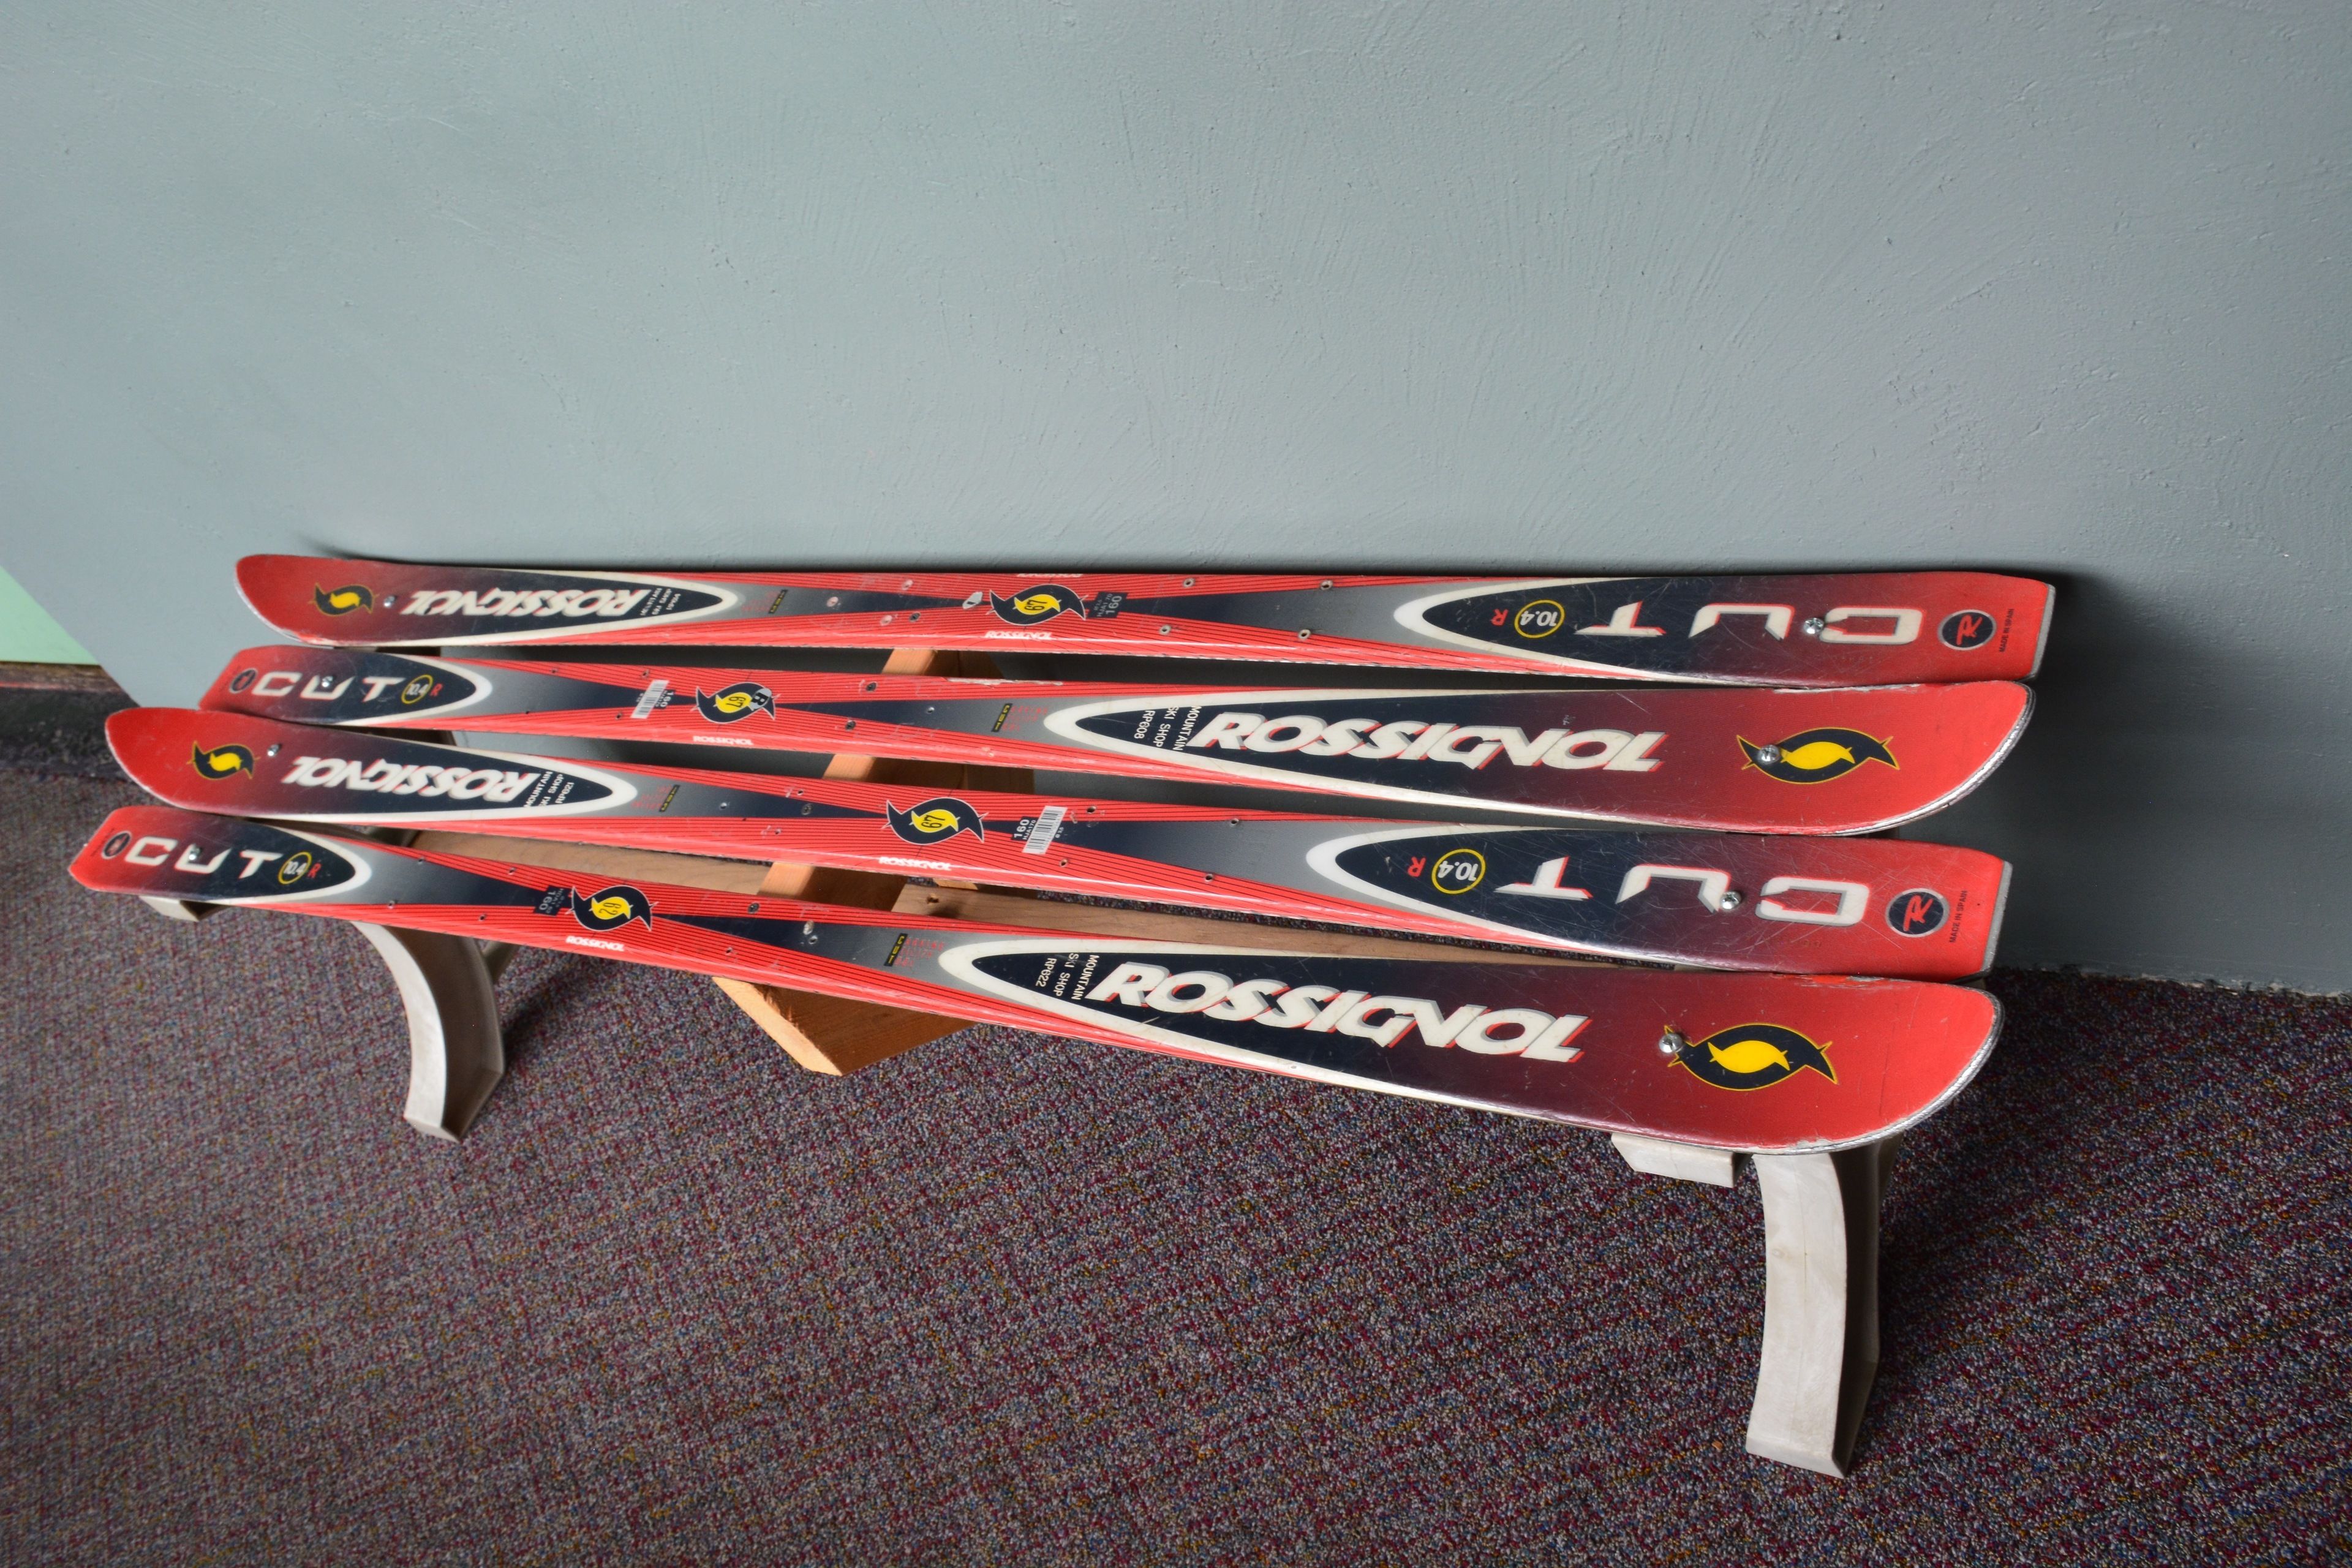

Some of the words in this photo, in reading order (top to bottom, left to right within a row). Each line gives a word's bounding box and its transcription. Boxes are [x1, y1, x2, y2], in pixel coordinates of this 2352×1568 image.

[401, 587, 651, 617] ROSSIGNOL
[1106, 596, 1122, 614] 160
[1491, 609, 1509, 626] R
[1520, 611, 1558, 627] 10.4
[1574, 600, 1926, 645] CUT
[252, 671, 407, 703] CUT
[430, 683, 443, 696] R
[1164, 705, 1180, 720] SKI
[1134, 710, 1156, 739] RP608
[1153, 723, 1171, 747] SHOP
[1172, 705, 1202, 750] MOUNTAIN
[692, 735, 754, 746] ROSSIGNOL
[1185, 712, 1667, 772] ROSSIGNOL
[281, 756, 542, 802] ROSSIGNOL
[548, 774, 564, 794] SHOP
[921, 813, 945, 829] 67
[1013, 819, 1030, 838] 160
[125, 836, 284, 879] CUT
[283, 861, 307, 876] 10.4
[879, 856, 952, 871] ROSSIGNOL
[1407, 856, 1427, 878] R
[307, 862, 322, 878] R
[1438, 861, 1479, 881] 10.4
[539, 891, 556, 910] 160
[1493, 855, 1869, 927] CUT
[1949, 923, 1961, 943] MADE
[1957, 890, 1968, 911] SPAIN
[566, 935, 625, 952] ROSSIGNOL
[889, 936, 905, 964] CUT
[1064, 952, 1079, 968] SKI
[1035, 957, 1057, 987] RP622
[1071, 954, 1100, 1000] MOUNTAIN
[1054, 972, 1071, 997] SHOP
[1084, 961, 1592, 1063] ROSSIGNOL
